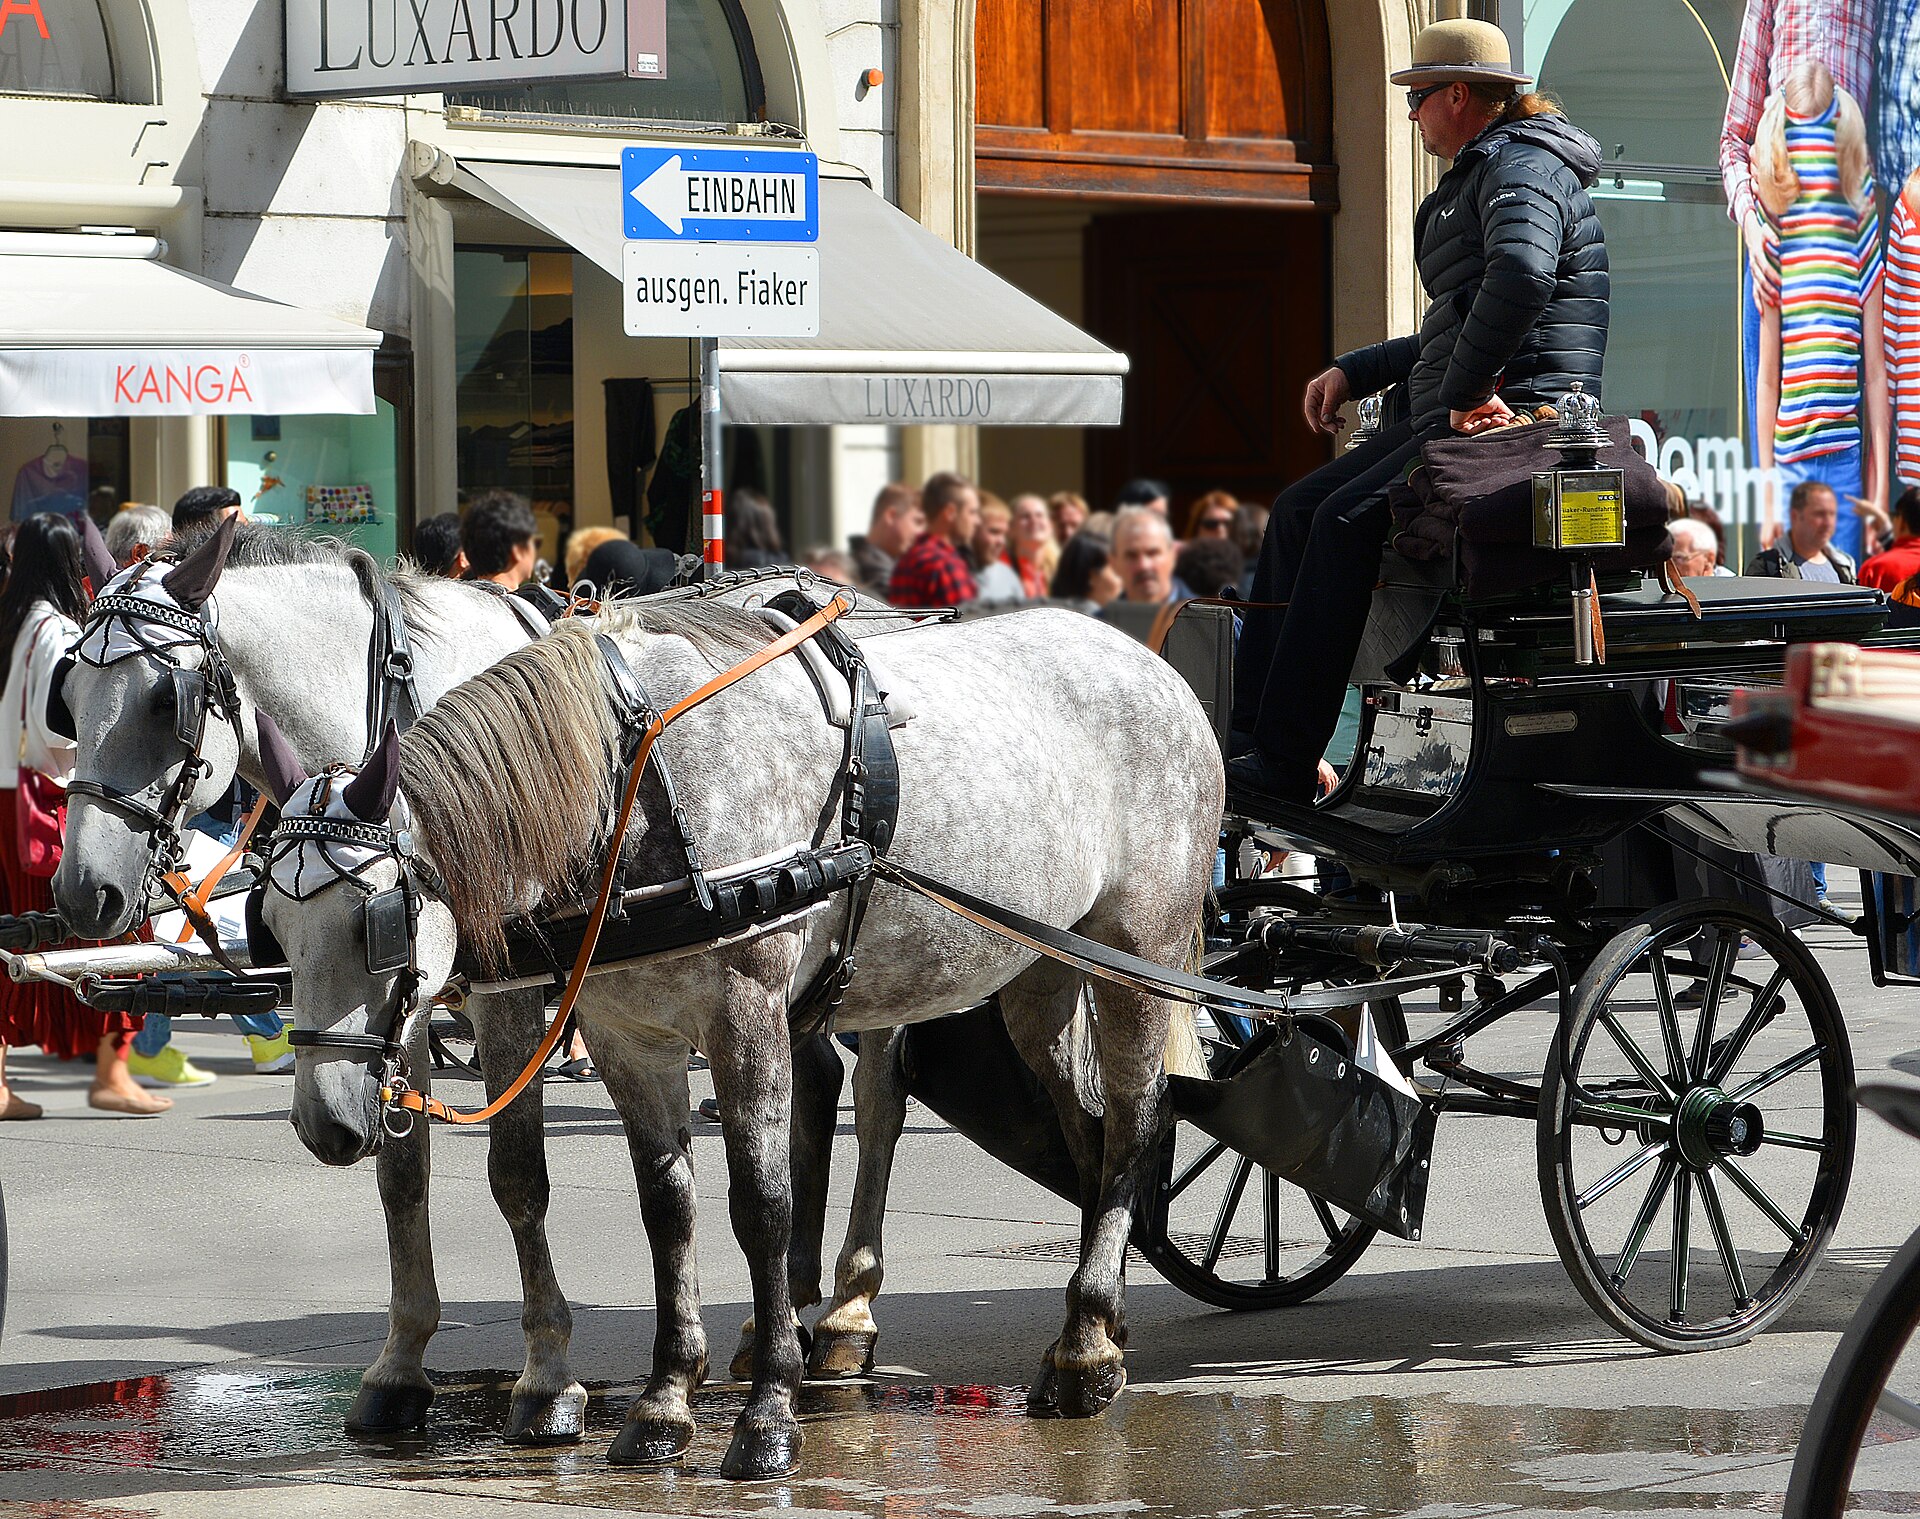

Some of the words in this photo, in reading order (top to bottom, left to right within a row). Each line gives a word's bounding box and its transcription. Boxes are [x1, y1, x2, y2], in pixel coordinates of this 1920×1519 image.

[314, 0, 608, 72] LUXARDO
[687, 176, 796, 214] EINBAHN
[636, 276, 728, 312] ausgen.
[738, 269, 808, 306] Fiaker
[114, 364, 253, 404] KANGA
[863, 377, 991, 418] LUXARDO
